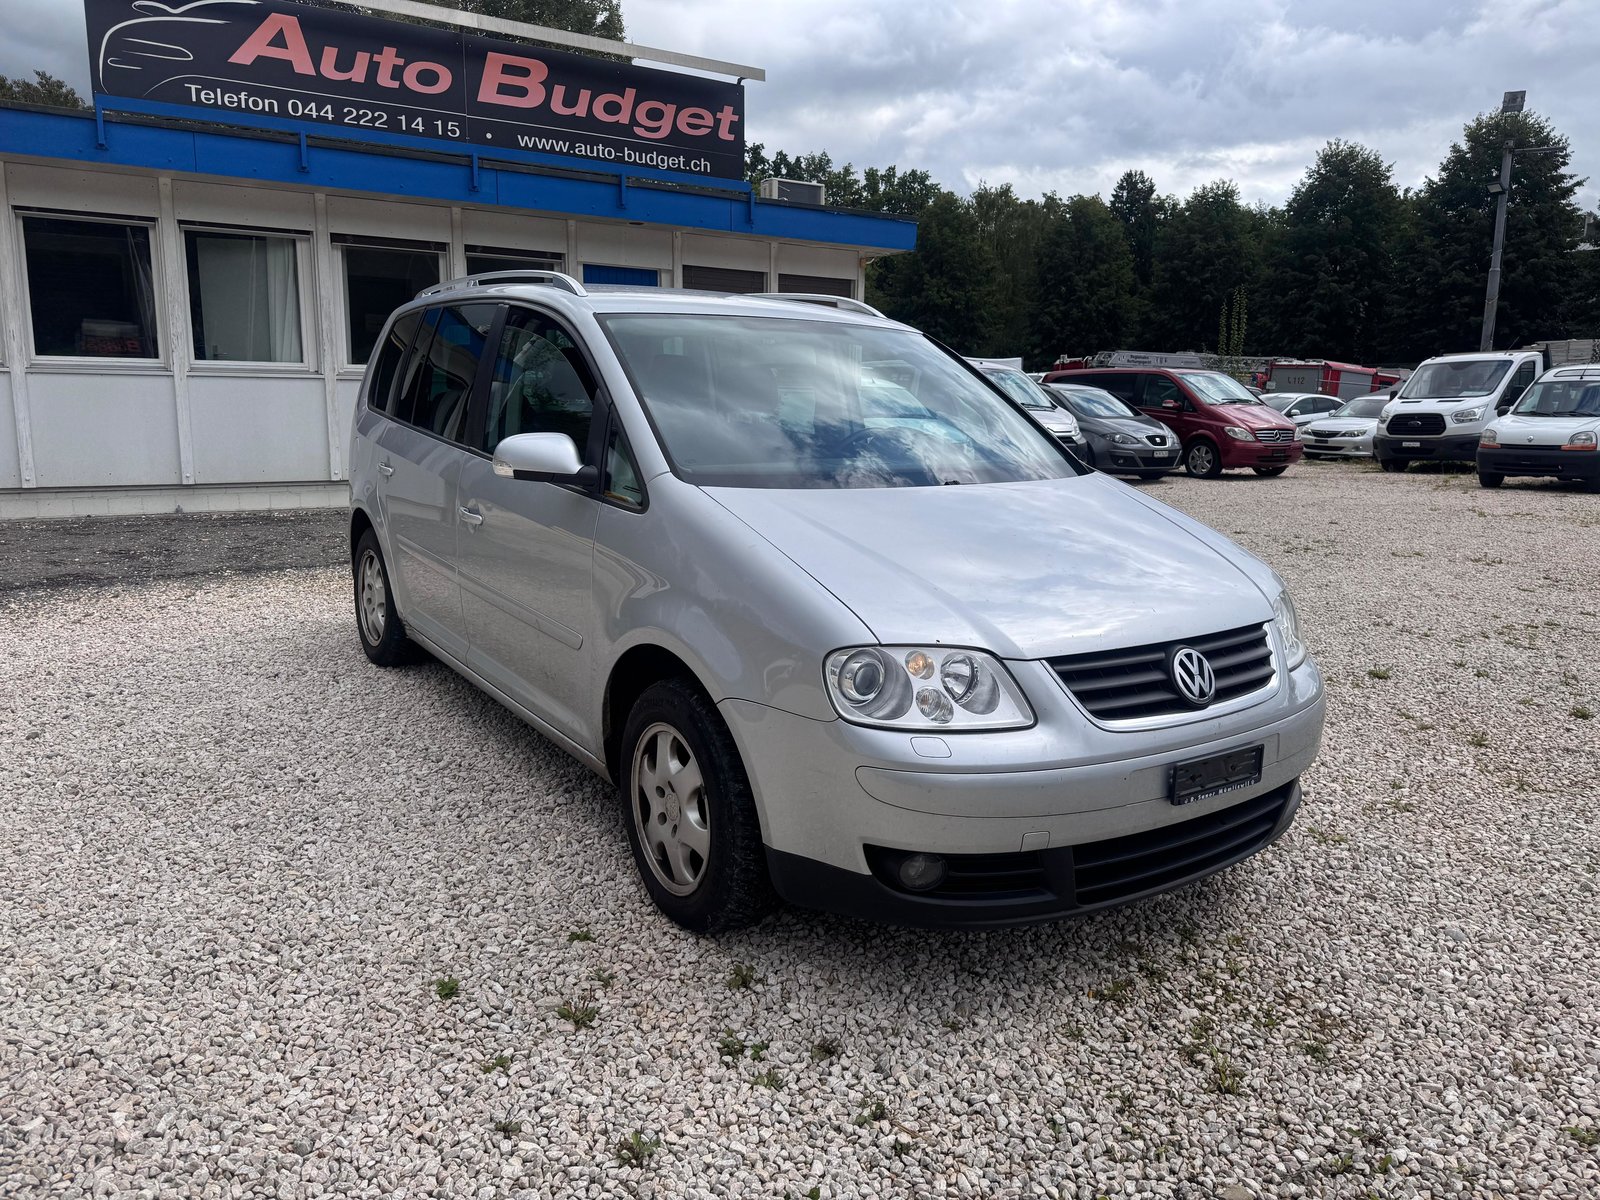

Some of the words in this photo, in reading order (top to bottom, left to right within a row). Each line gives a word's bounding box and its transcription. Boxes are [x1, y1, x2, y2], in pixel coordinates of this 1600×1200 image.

[227, 12, 453, 94] Auto
[476, 51, 739, 141] Budget
[184, 83, 279, 113] Telefon
[288, 99, 334, 121] 044
[343, 107, 389, 129] 222
[397, 114, 425, 133] 14
[433, 119, 461, 138] 15
[517, 133, 711, 173] www.auto-budget.ch
[1175, 649, 1213, 701] VW
